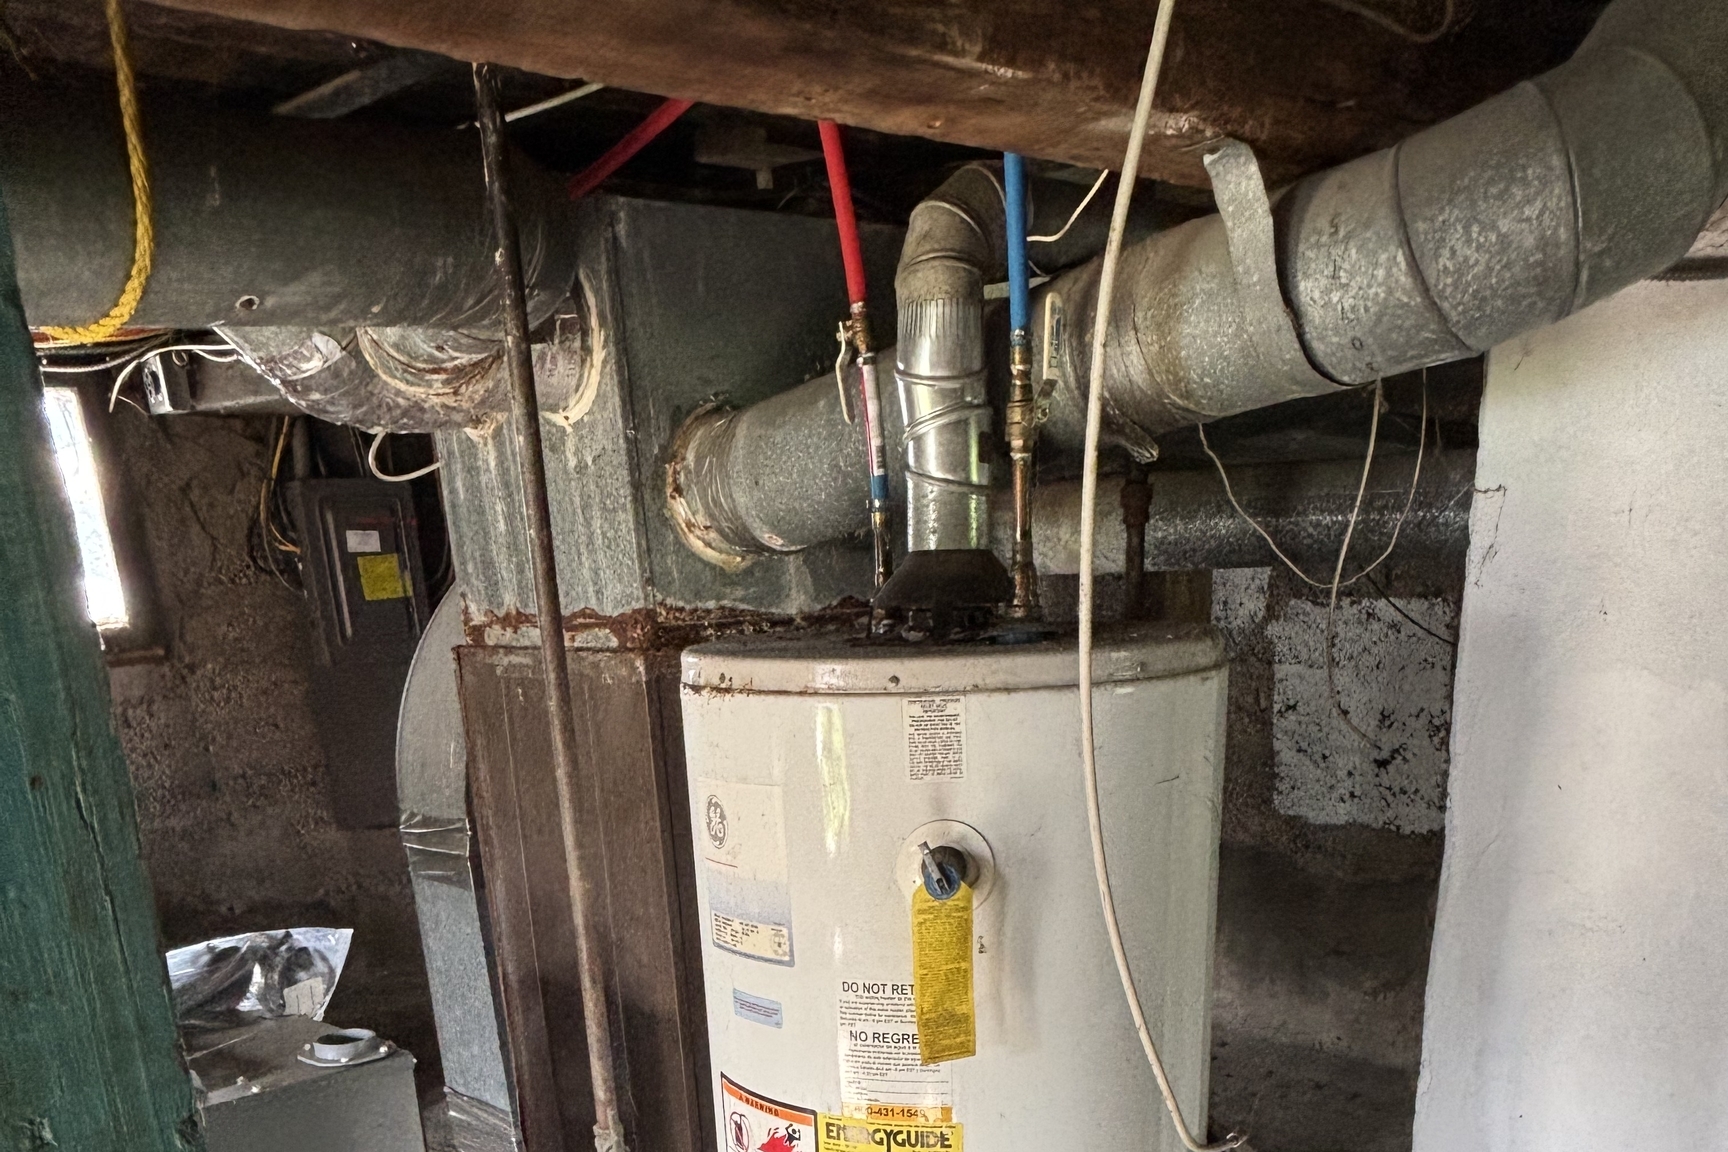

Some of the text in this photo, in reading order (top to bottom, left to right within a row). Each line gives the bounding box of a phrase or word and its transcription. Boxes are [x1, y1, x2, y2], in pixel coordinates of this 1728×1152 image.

[842, 981, 915, 996] DO NOT RET
[849, 1030, 921, 1045] NO REGRE
